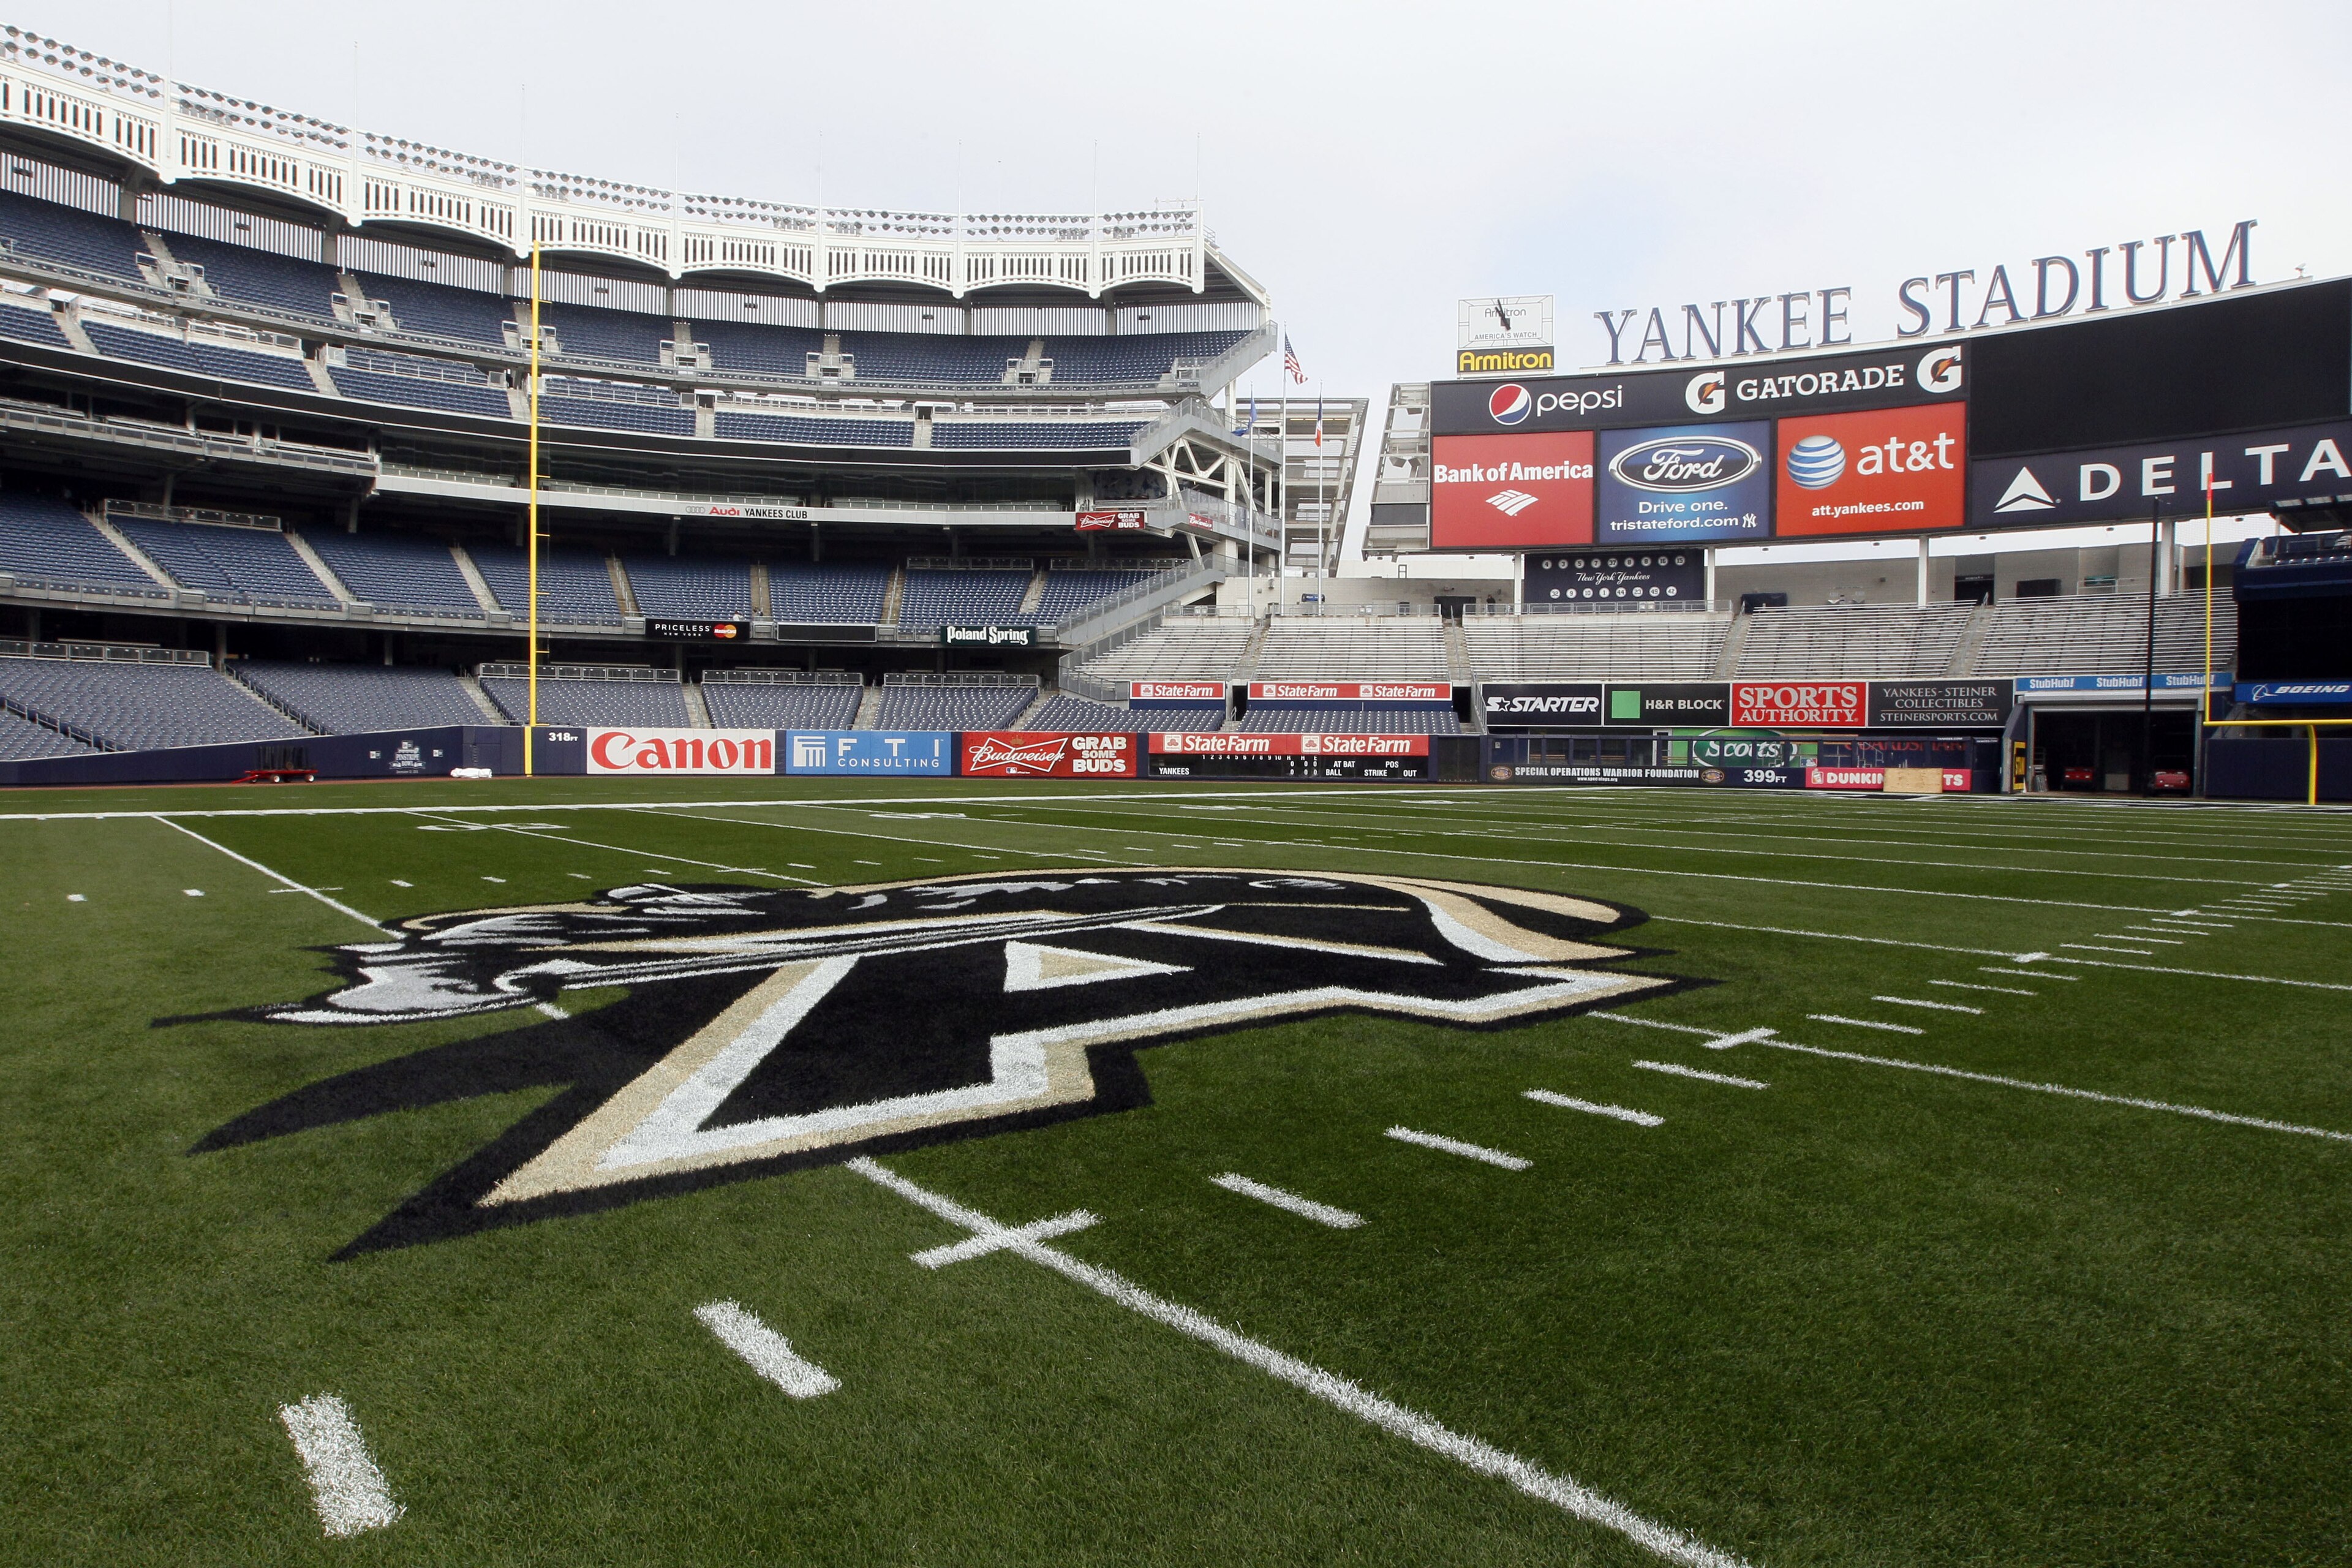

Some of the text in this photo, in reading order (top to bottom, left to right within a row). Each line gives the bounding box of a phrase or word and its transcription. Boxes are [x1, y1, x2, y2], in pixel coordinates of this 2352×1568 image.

[1594, 219, 2258, 366] YANKEE STADIUM
[1485, 307, 1526, 317] Armitron
[1460, 352, 1553, 371] Armitron
[1736, 364, 1904, 401] GATORADE
[1537, 385, 1623, 417] pepsi
[1856, 432, 1954, 475] at&t
[1643, 448, 1724, 481] Ford
[2080, 439, 2352, 502] DELTA
[1434, 461, 1594, 483] Bank of America
[709, 507, 807, 519] Audi YANKEES CLUB
[1638, 500, 1728, 514] Drive one.
[1812, 501, 1924, 518] att.yankees.com
[1610, 517, 1738, 530] tristateford.com
[1576, 571, 1650, 585] New York Yankees
[655, 624, 710, 632] PRICELESS
[947, 626, 1028, 645] Poland Spring
[2030, 678, 2075, 688] StubHub!
[2097, 677, 2143, 687] StubHub!
[2166, 674, 2214, 685] StubHu!
[1883, 688, 1937, 697] YANKEES
[1945, 687, 1997, 696] STEINER
[2274, 685, 2350, 693] BOEING
[1512, 697, 1599, 712] STARTER
[1739, 686, 1858, 709] SPORTS
[1895, 698, 1983, 708] COLLECTIBLES
[1646, 700, 1722, 710] H&R BLOCK
[1739, 709, 1856, 722] AUTHORITY
[1880, 712, 1998, 721] STEINERSPORTS.COM
[591, 731, 772, 769] Canon
[1072, 736, 1127, 750] GRAB
[969, 745, 1065, 762] Budweiser
[838, 758, 939, 767] CONSULTING
[1072, 759, 1126, 772] BUDS
[1515, 767, 1548, 776] SPECIAL
[1550, 767, 1600, 777] OPERATIONS
[1602, 768, 1643, 777] WARRIOR
[1645, 769, 1699, 778] FOUNDATION
